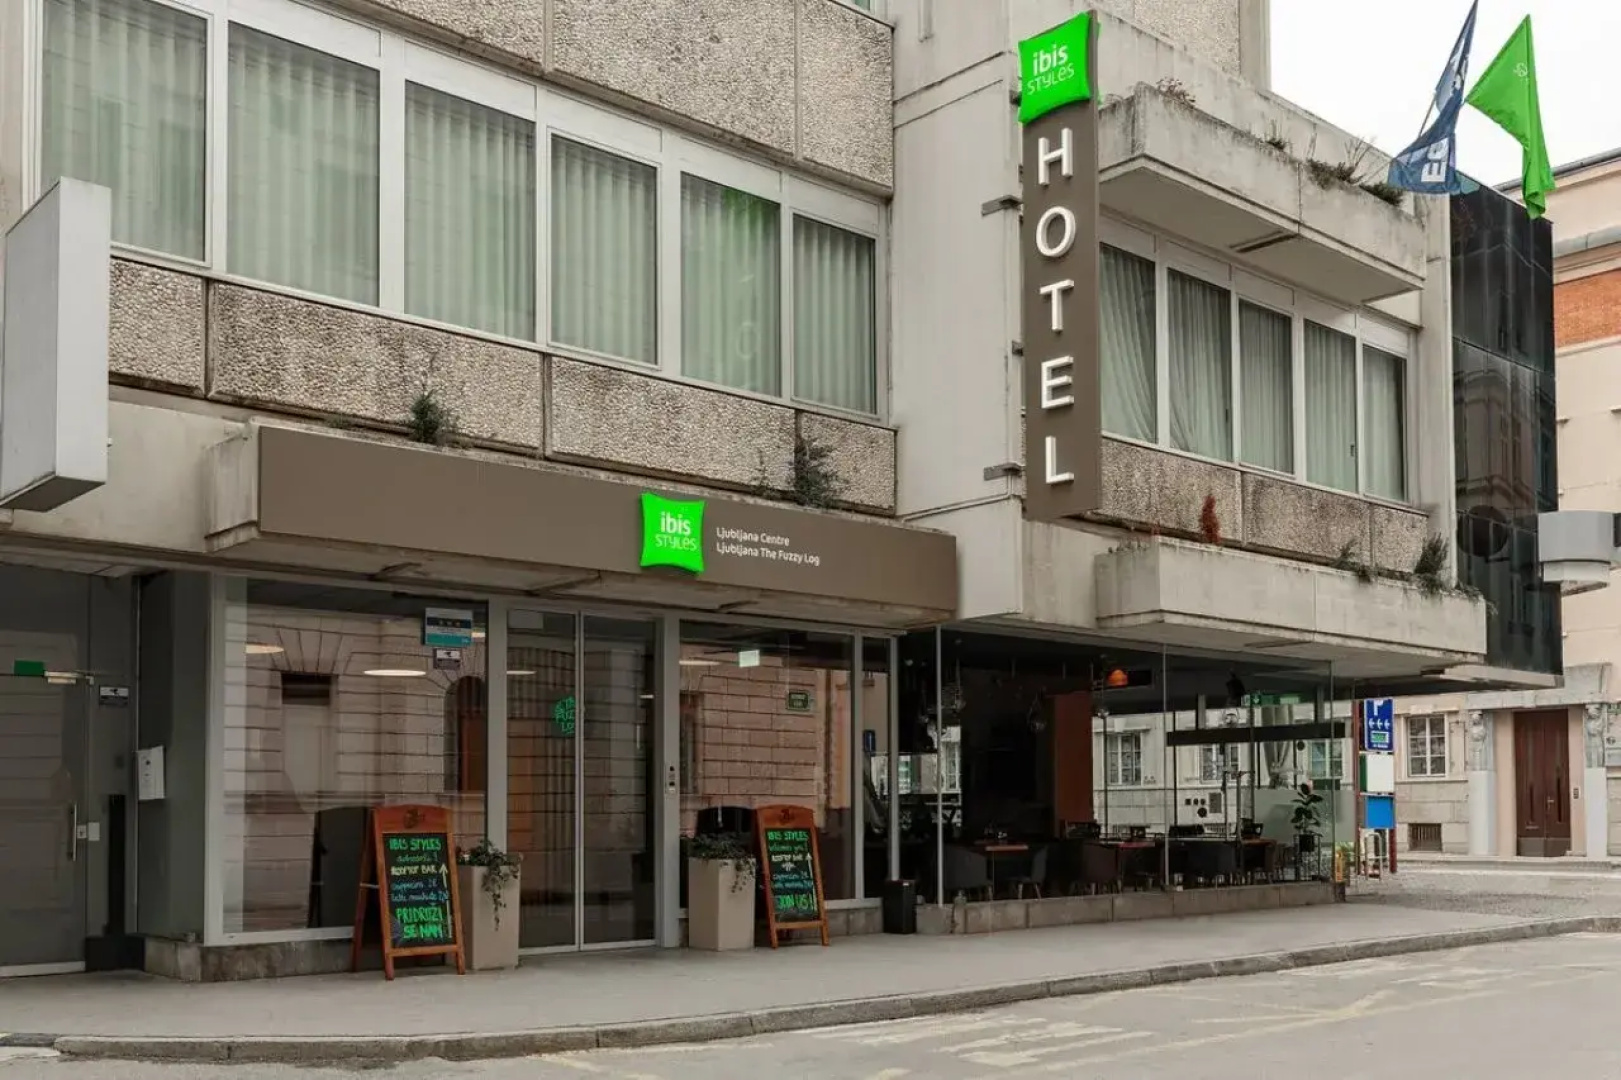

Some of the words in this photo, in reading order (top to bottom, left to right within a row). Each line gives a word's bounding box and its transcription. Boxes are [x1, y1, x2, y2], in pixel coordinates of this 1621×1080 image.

[1032, 43, 1069, 76] ibis
[1035, 126, 1076, 484] HOTEL
[660, 511, 691, 536] ibis
[716, 526, 759, 543] Ljubljana
[760, 532, 790, 547] Centre
[716, 541, 759, 558] Ljubljana
[760, 547, 777, 560] The
[778, 550, 803, 564] Fuzzy
[804, 552, 820, 567] Log
[409, 837, 441, 851] STYLES
[403, 924, 417, 938] SE
